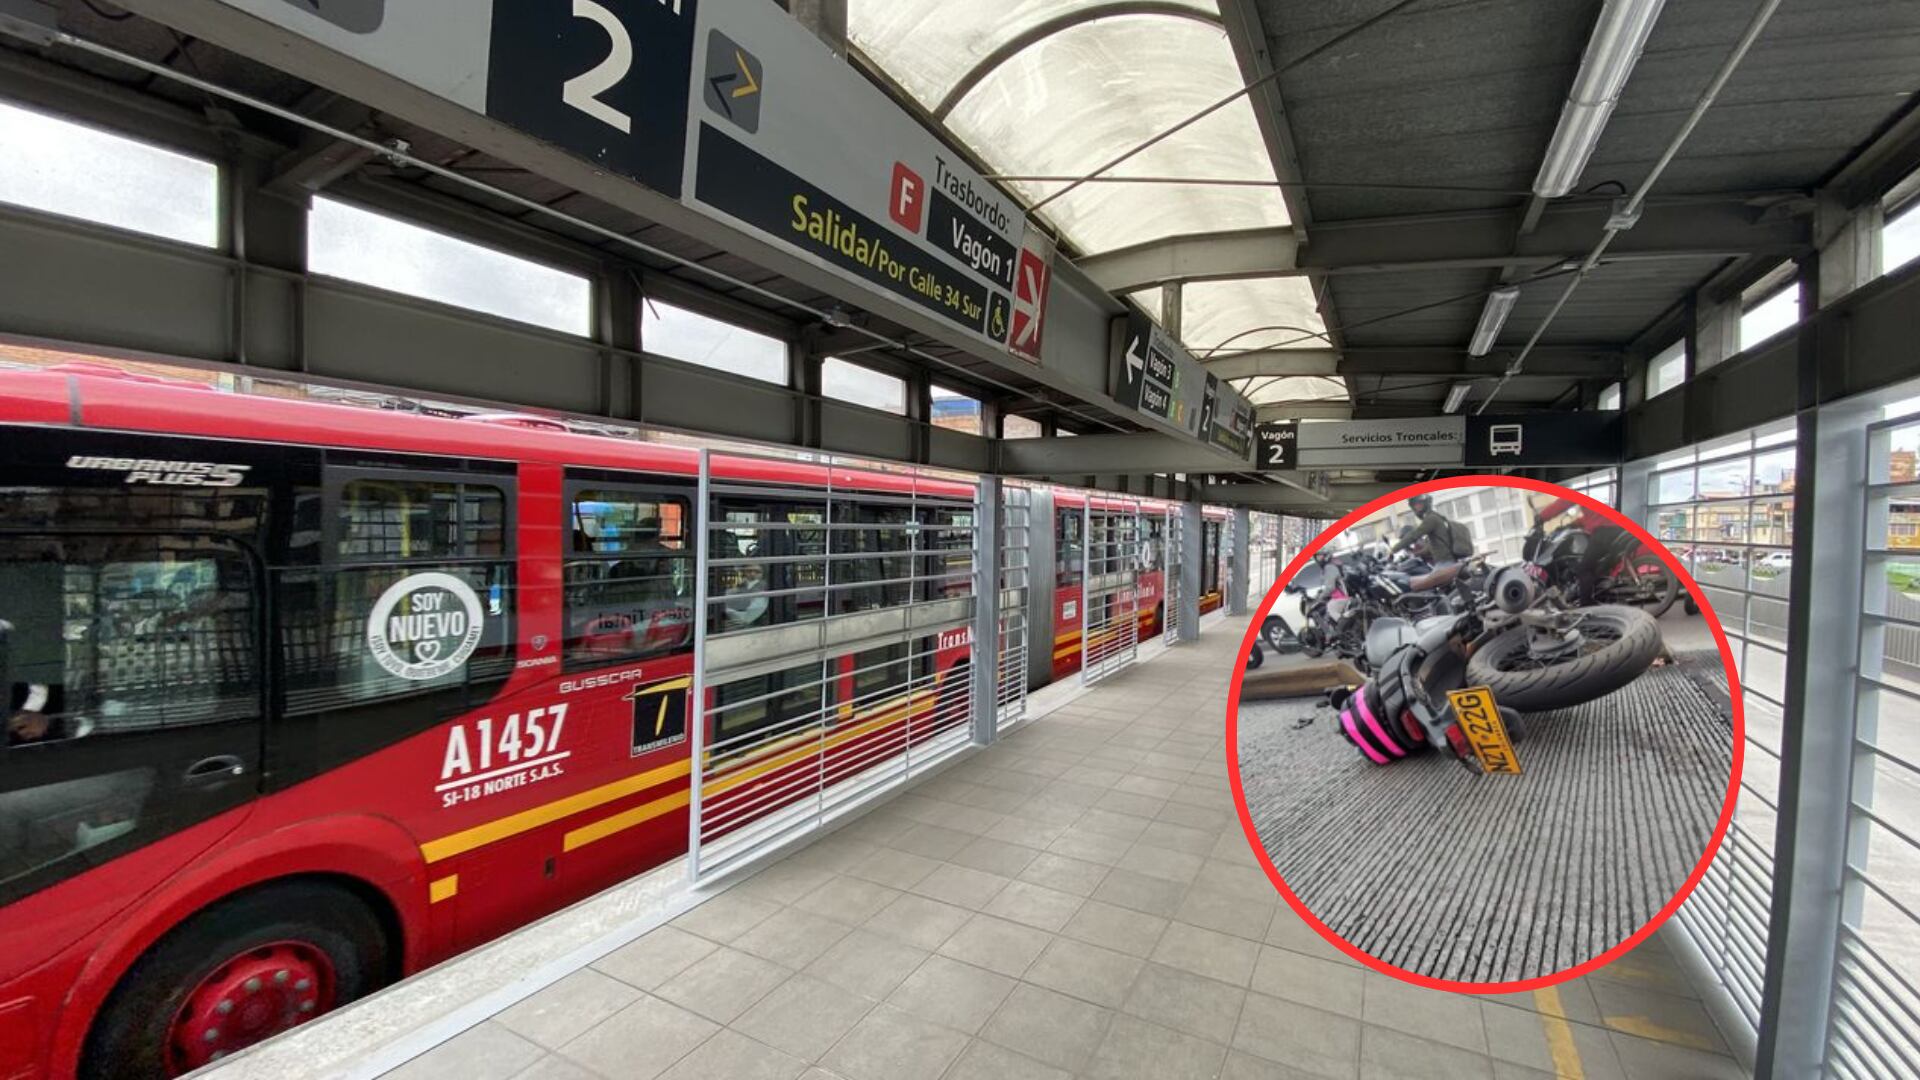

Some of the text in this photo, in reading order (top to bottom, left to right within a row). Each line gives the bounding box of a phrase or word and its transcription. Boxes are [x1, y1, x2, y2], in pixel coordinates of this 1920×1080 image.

[563, 0, 632, 134] 2
[901, 177, 914, 215] F
[936, 156, 1010, 234] Trasbordo:
[952, 217, 1013, 283] Vagón 1
[909, 267, 942, 301] Calle
[944, 285, 960, 310] 34
[963, 295, 982, 320] Sur
[1261, 430, 1294, 441] Vagón
[1269, 444, 1284, 464] 2
[1342, 430, 1458, 444] Servicios Troncales:
[412, 592, 443, 612] SOY
[390, 611, 464, 642] NUEVO
[560, 669, 642, 693] BUSSCAR
[441, 703, 568, 779] A1457
[443, 763, 564, 808] SI-18 NORTE S.A.S.
